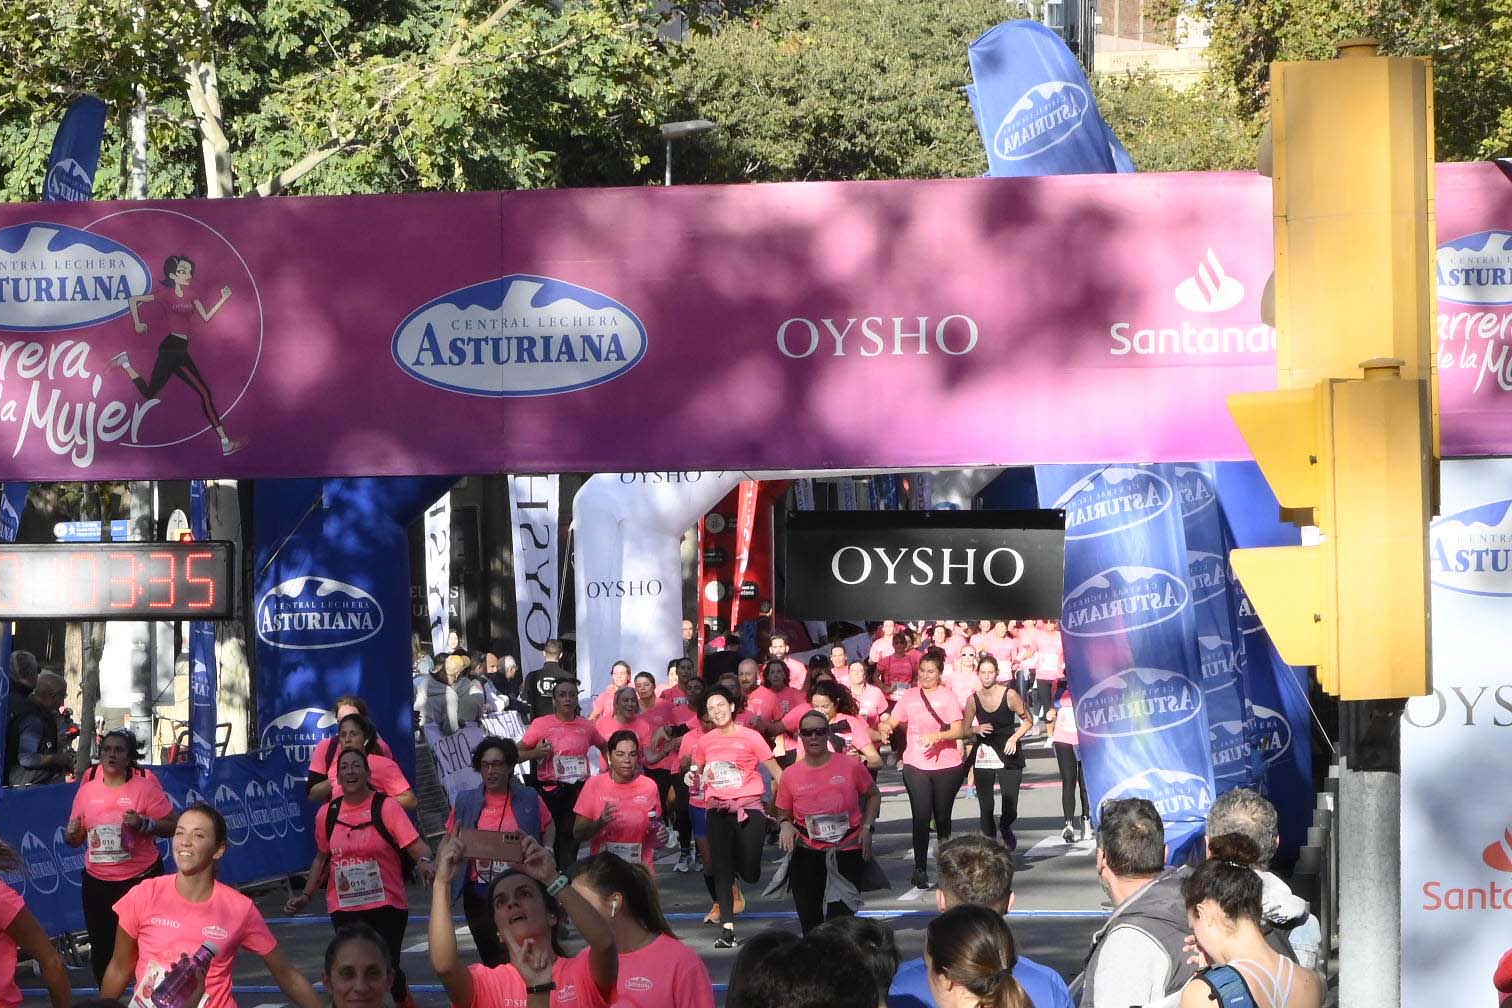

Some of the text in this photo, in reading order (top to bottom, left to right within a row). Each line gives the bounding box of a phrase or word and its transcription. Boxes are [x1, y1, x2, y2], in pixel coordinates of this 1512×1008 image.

[53, 258, 127, 270] LECHERA
[451, 315, 618, 331] CENTRAL LECHERA
[776, 314, 979, 359] OYSHO
[412, 322, 627, 367] ASTURIANA
[1459, 341, 1478, 369] la
[12, 378, 161, 468] Mujer
[831, 546, 1025, 587] OYSHO
[587, 579, 662, 600] OYSHO
[261, 606, 375, 635] ASTURIANA
[150, 917, 182, 929] OYSHO
